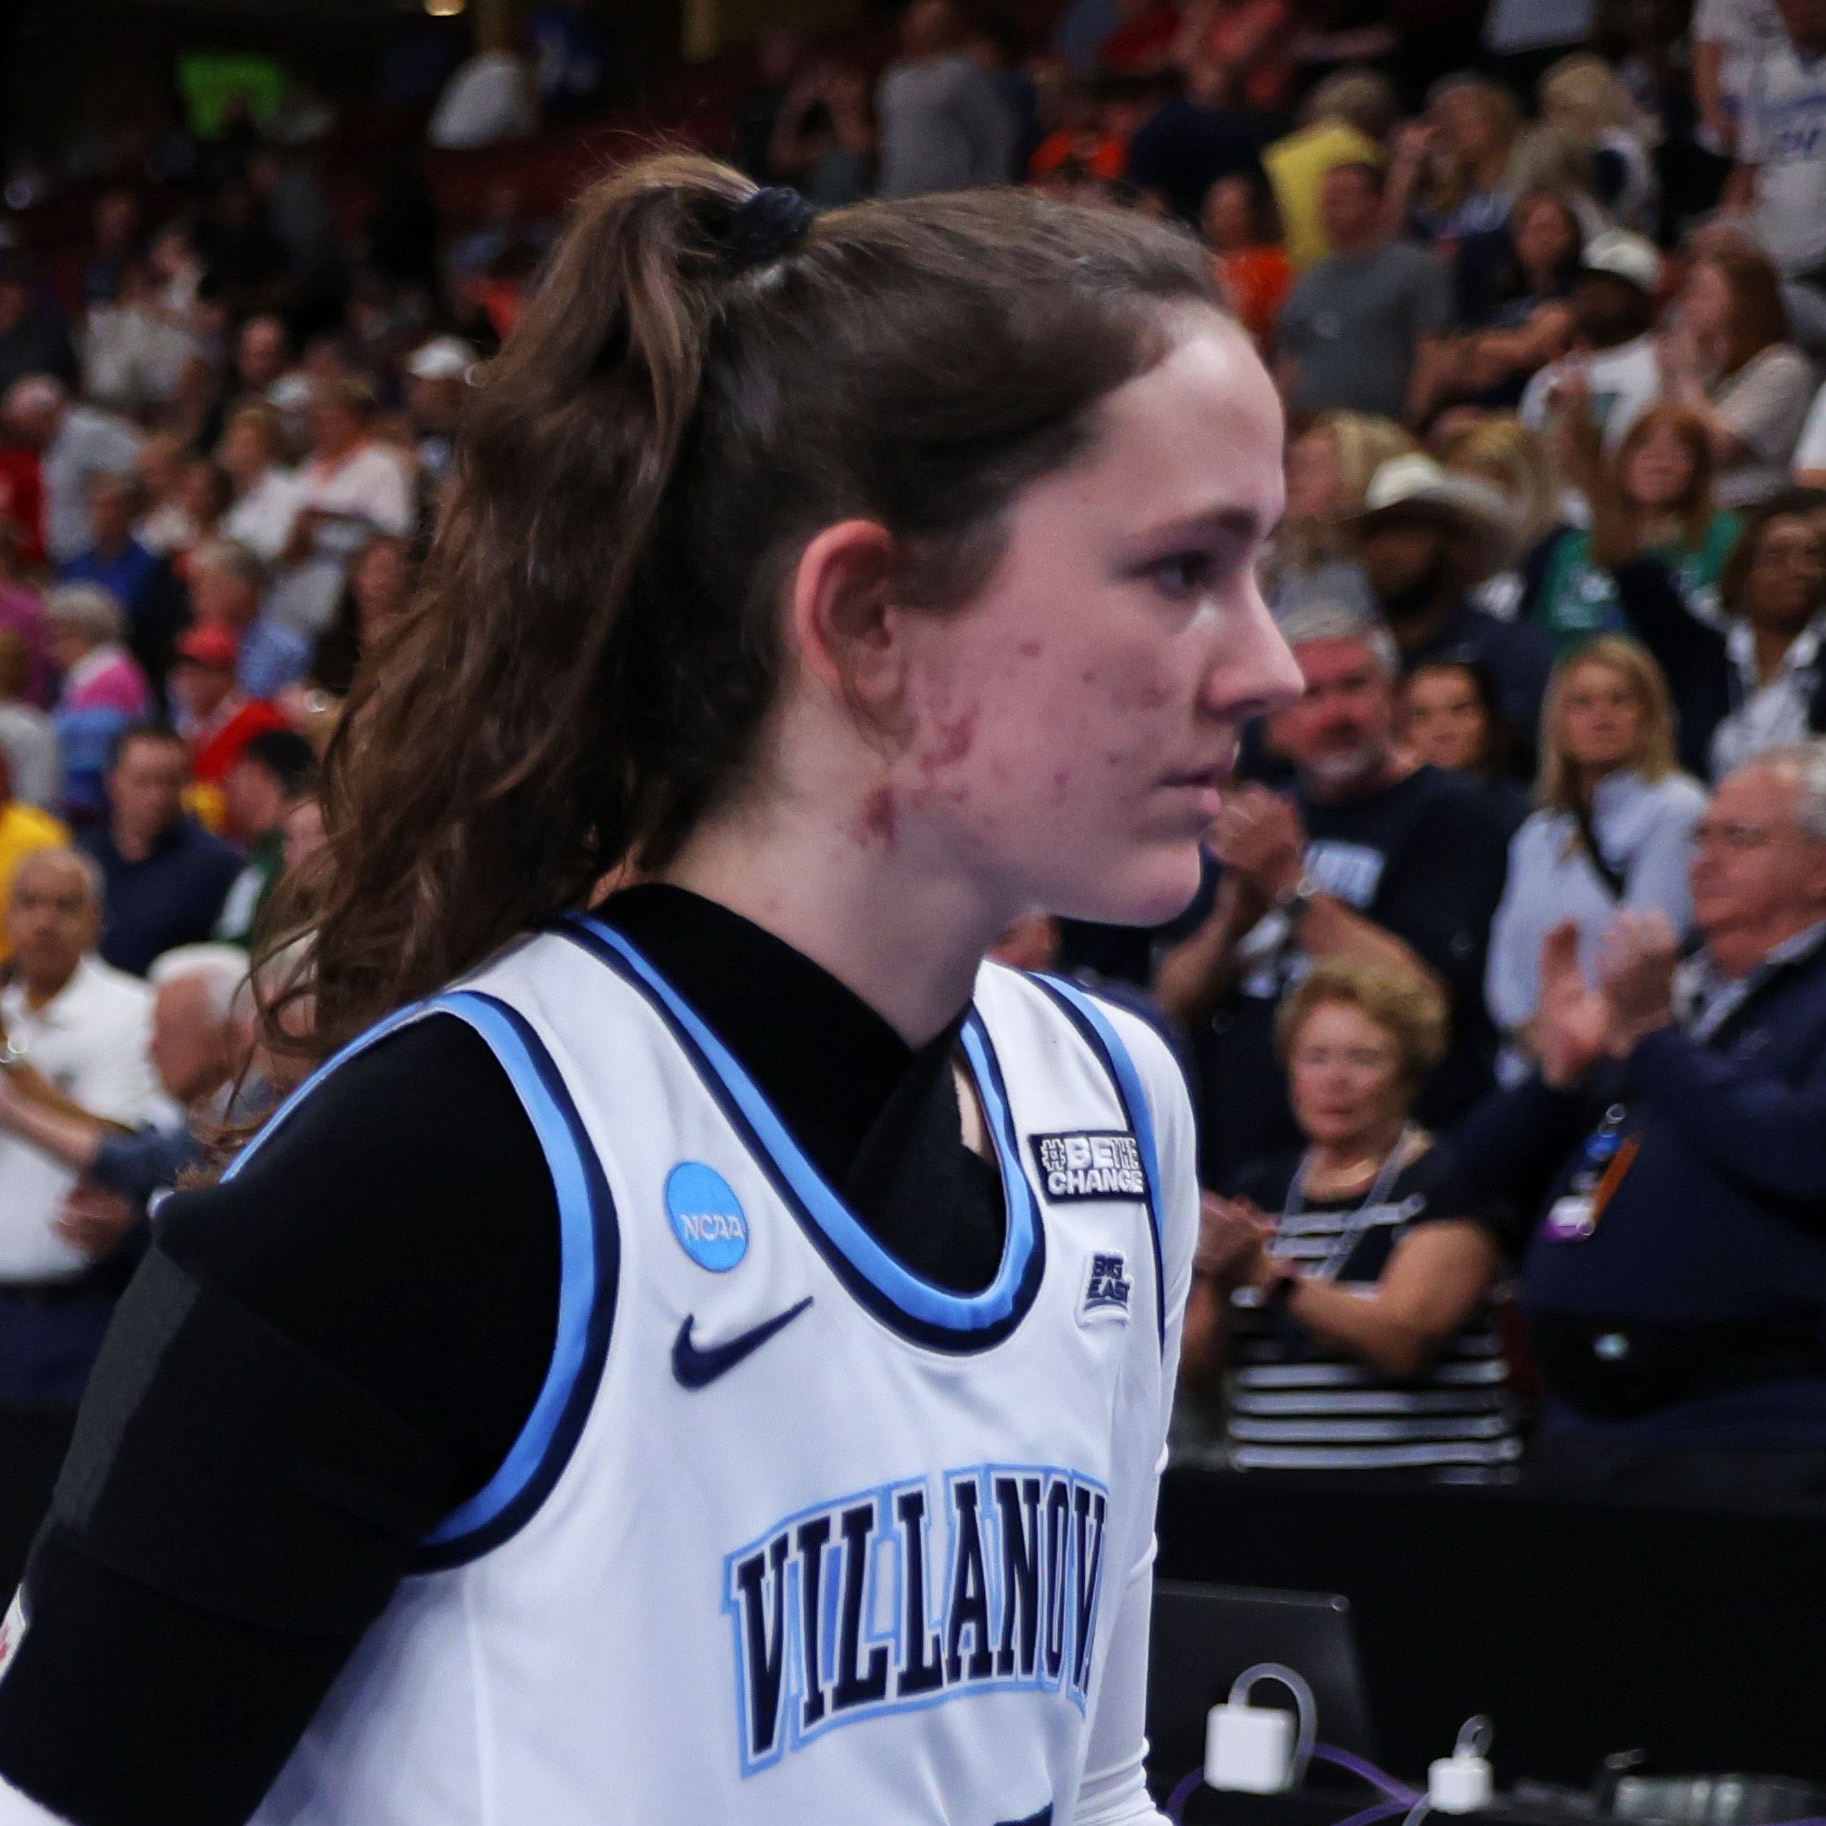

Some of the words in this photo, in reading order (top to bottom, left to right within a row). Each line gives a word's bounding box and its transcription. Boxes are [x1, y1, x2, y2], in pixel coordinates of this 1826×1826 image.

[1047, 1169, 1145, 1195] CHANGE
[680, 1214, 745, 1241] NCAA
[1092, 1254, 1125, 1280] BIG
[1087, 1278, 1131, 1302] EAST
